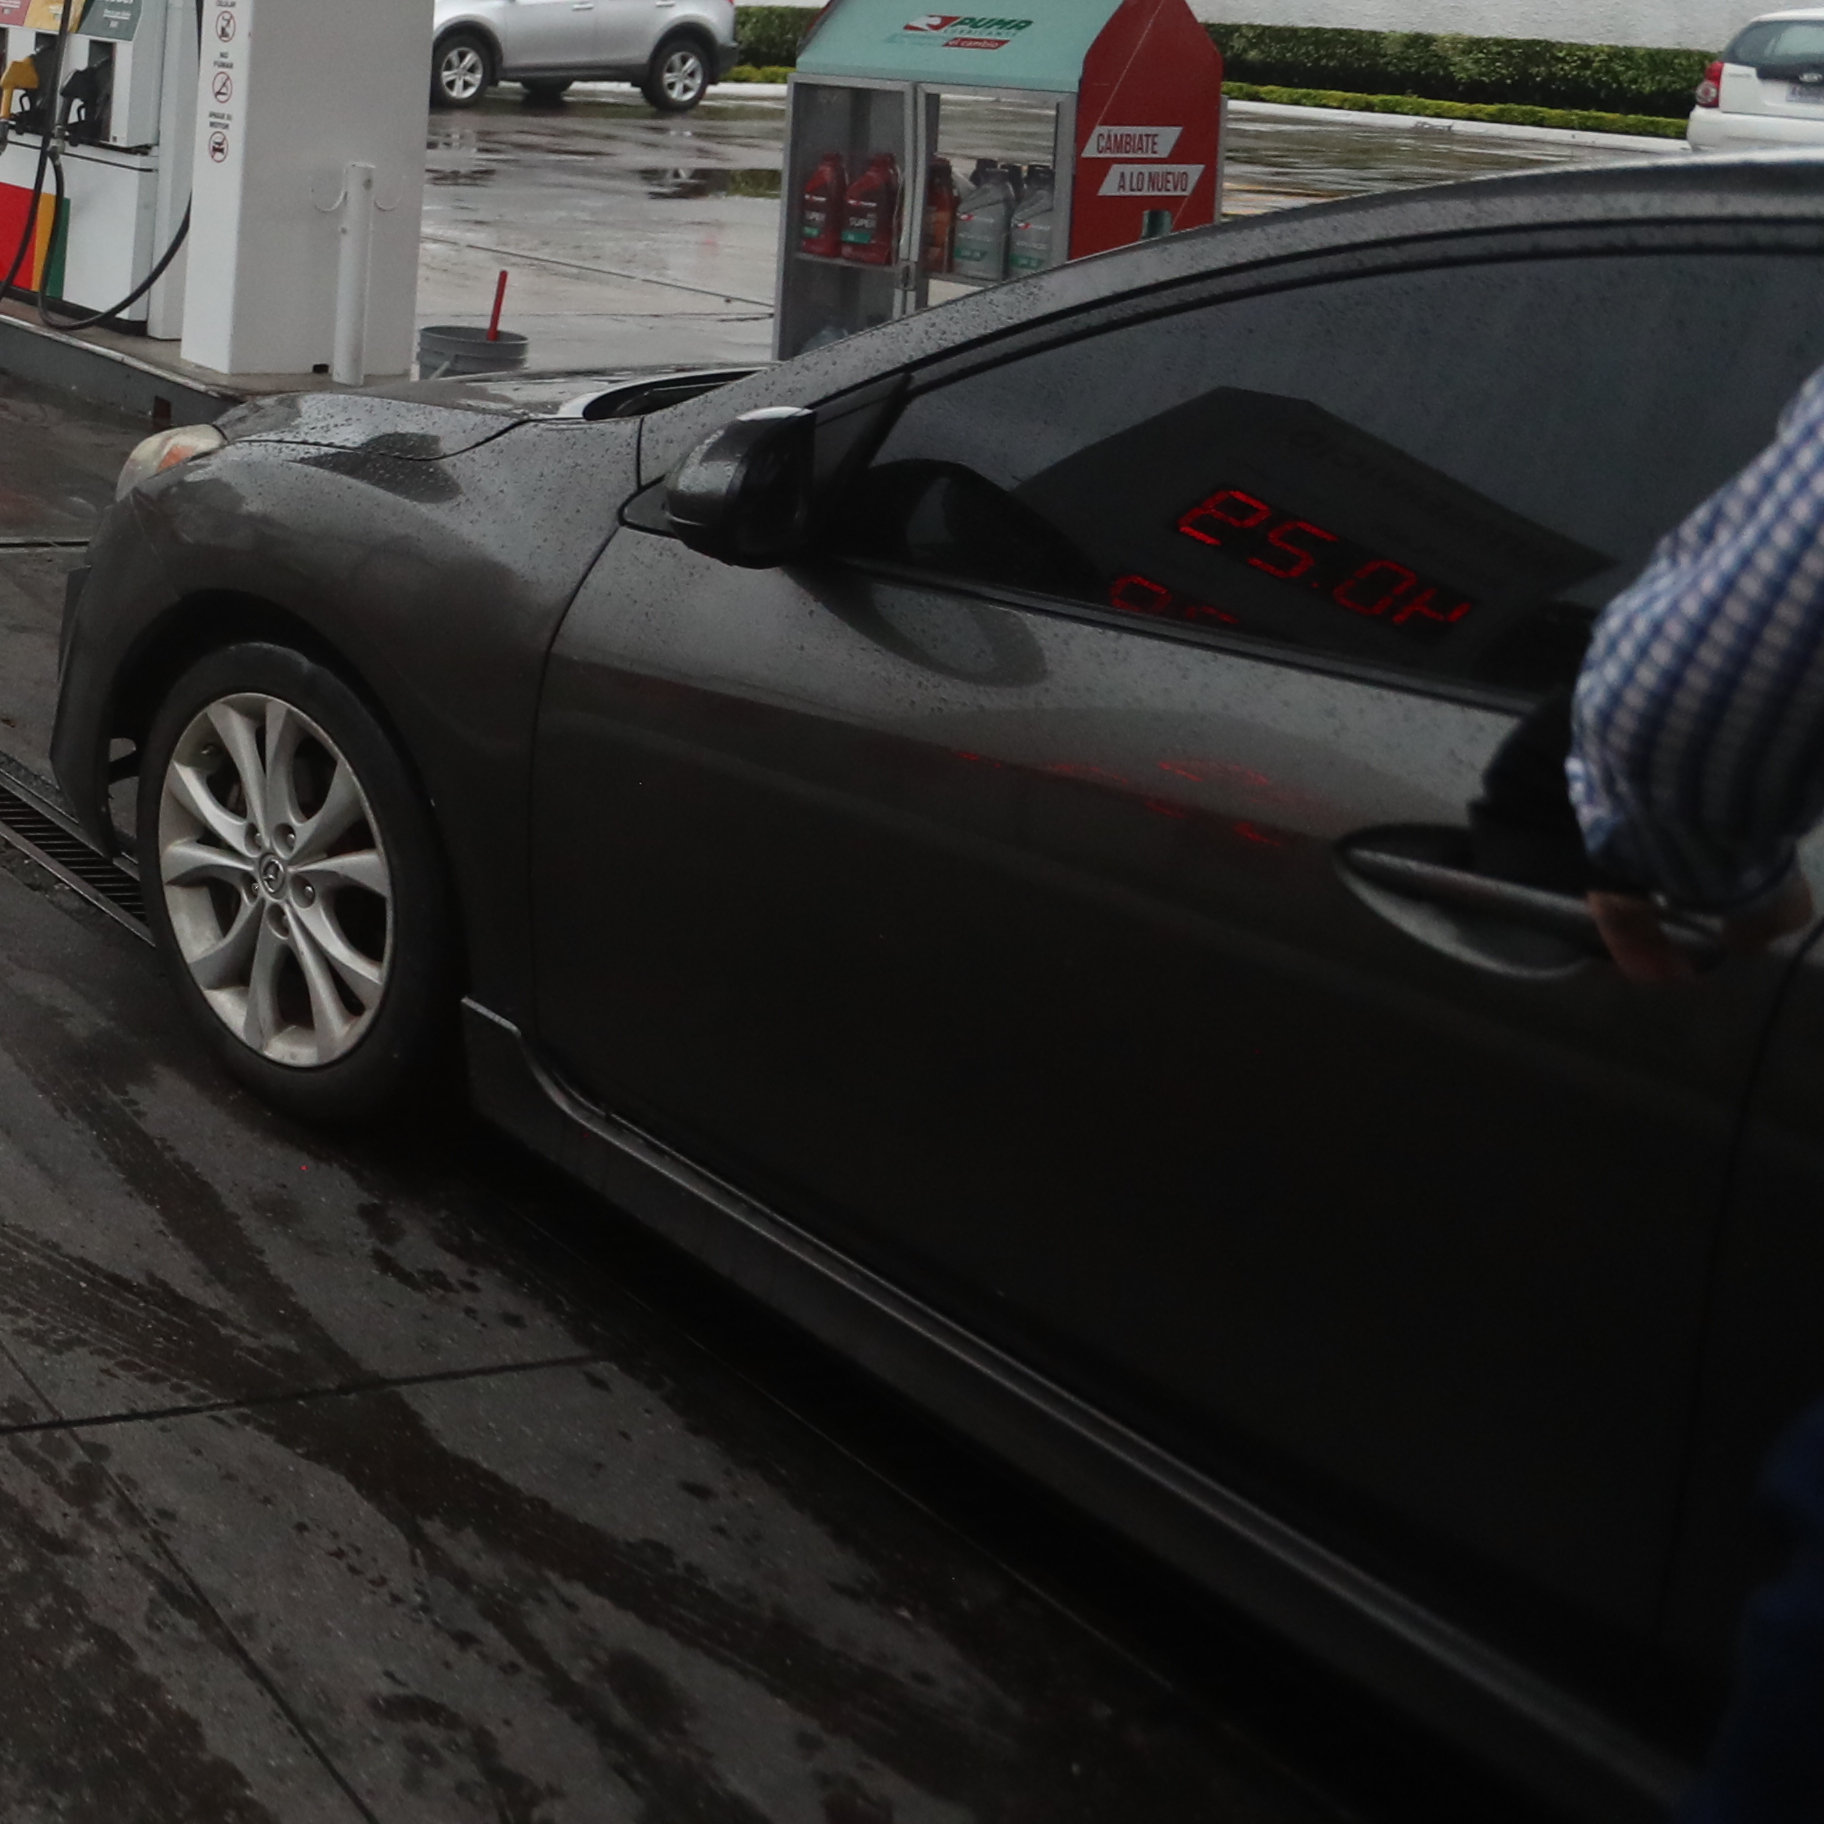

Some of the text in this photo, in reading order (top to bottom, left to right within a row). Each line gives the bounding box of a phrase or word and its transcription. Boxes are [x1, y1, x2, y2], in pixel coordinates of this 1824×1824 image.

[950, 17, 1035, 31] PUMA
[1096, 128, 1159, 154] CÁMBIATE
[1118, 171, 1189, 193] A LO NUEVO
